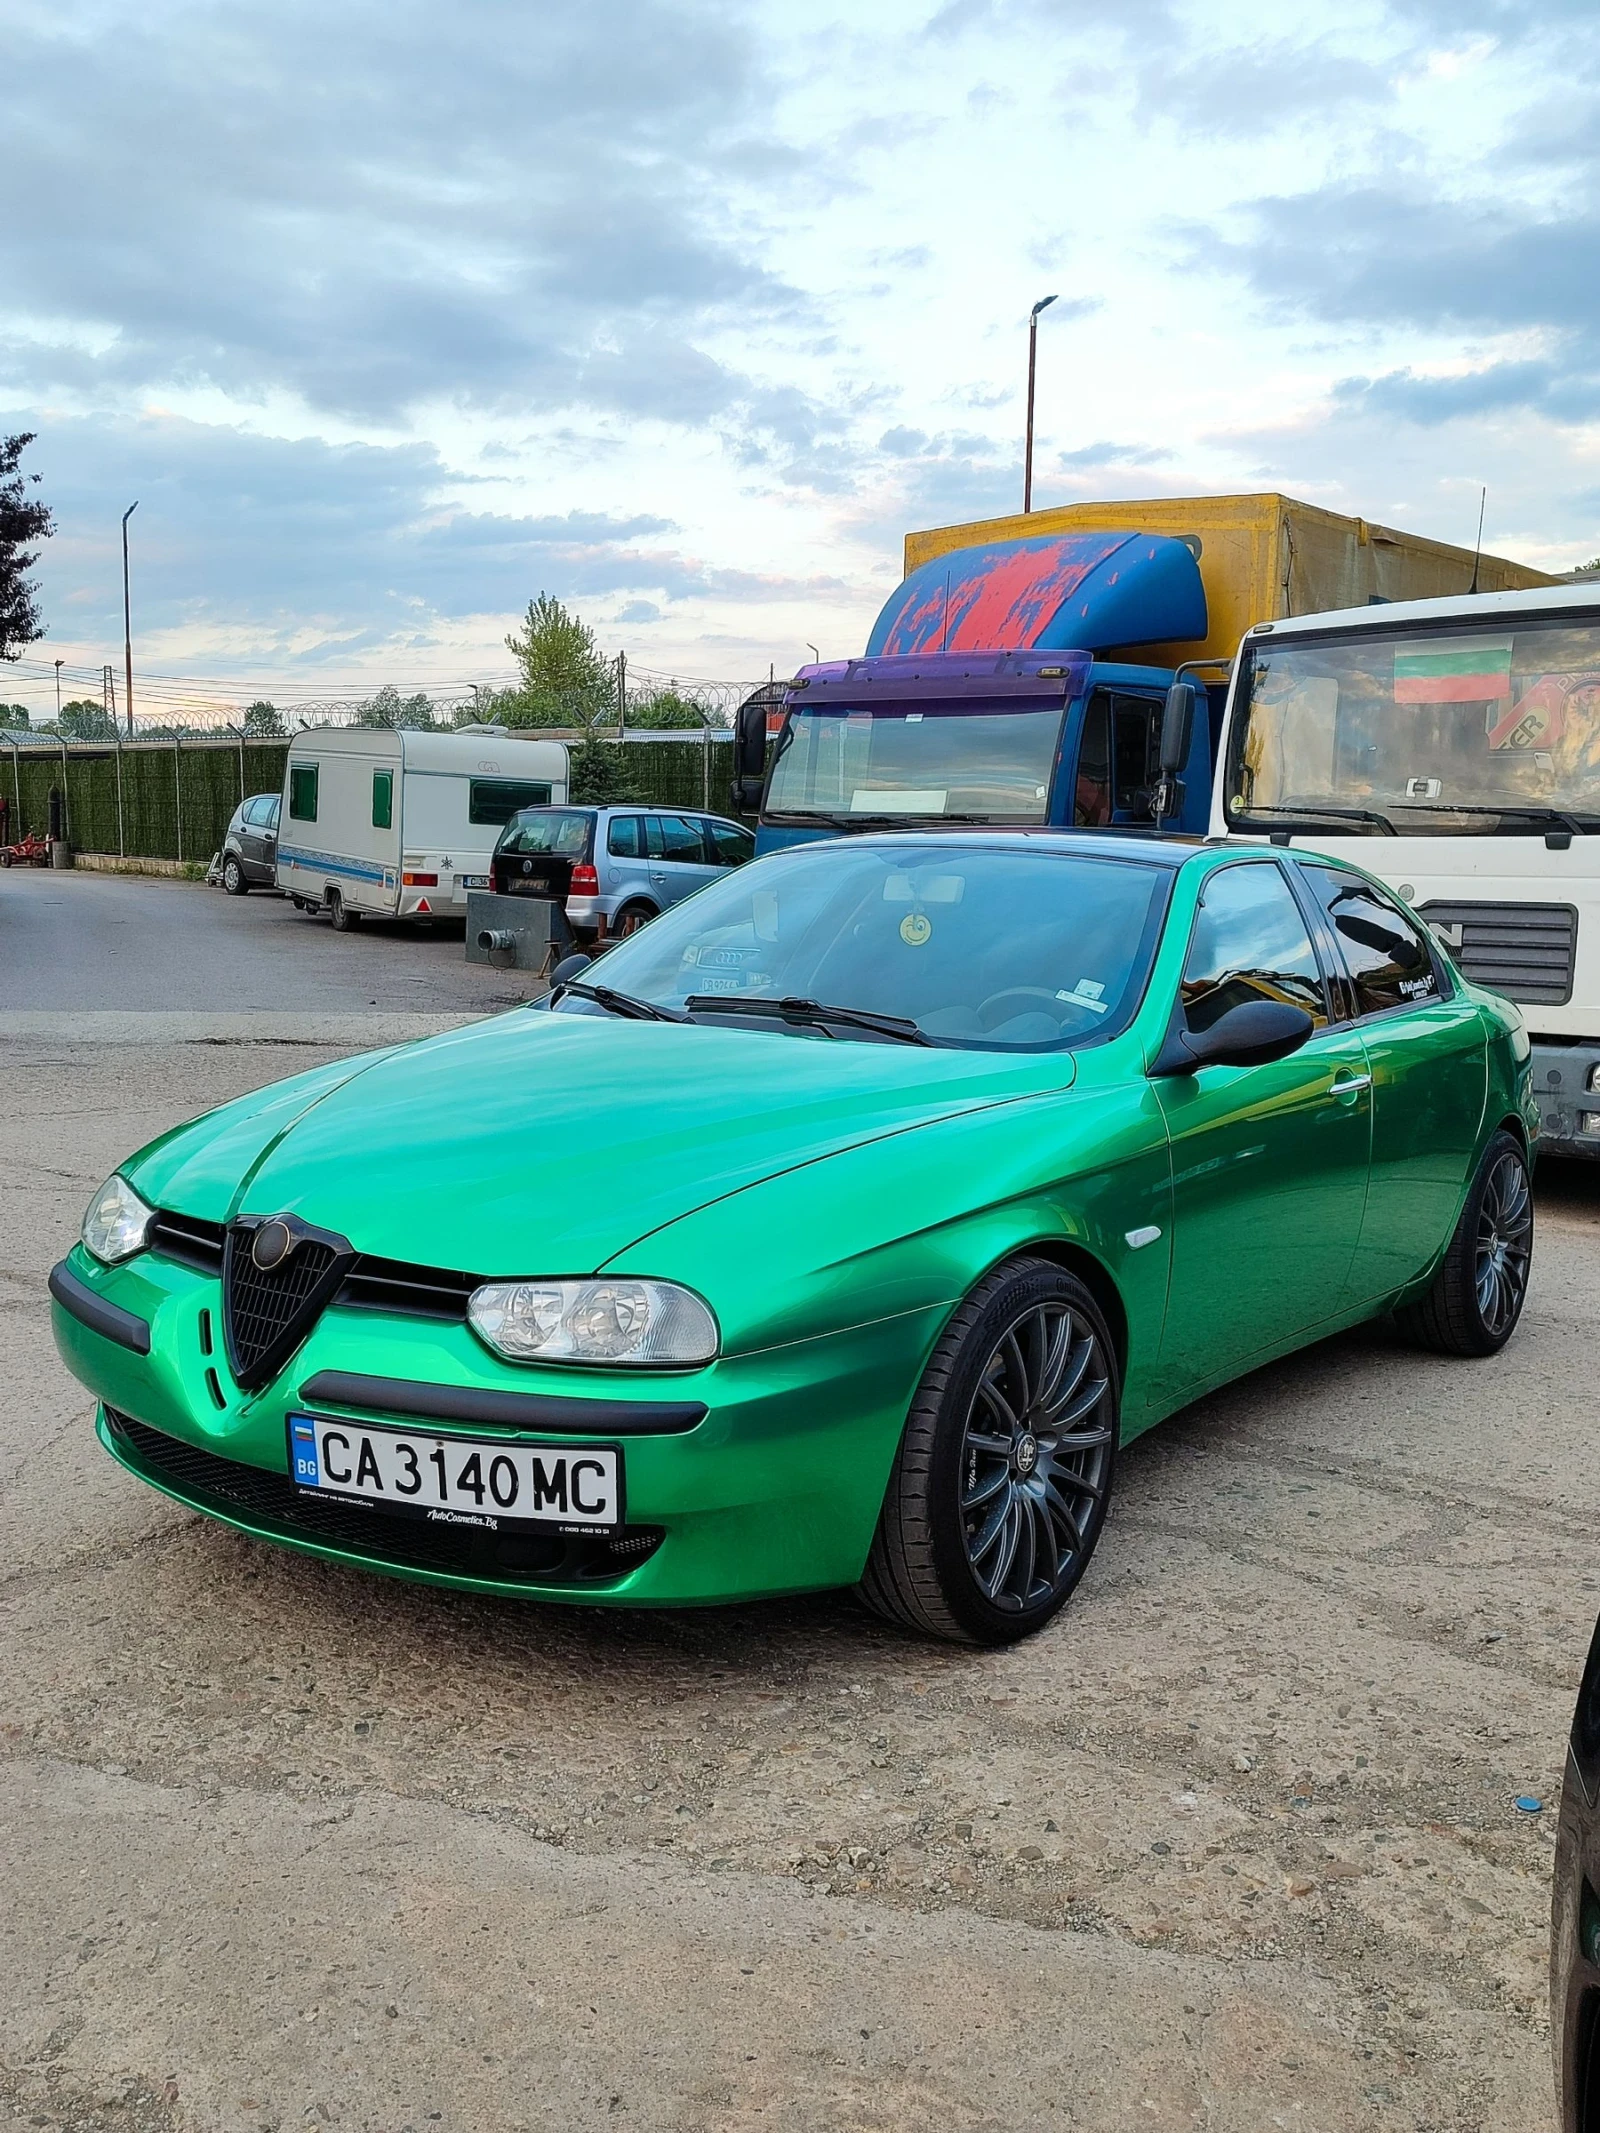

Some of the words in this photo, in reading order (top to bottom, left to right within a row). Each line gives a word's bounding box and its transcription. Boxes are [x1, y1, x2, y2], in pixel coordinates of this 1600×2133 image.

[297, 1458, 316, 1476] BG
[322, 1431, 384, 1491] CA
[395, 1443, 520, 1508] 3140
[532, 1457, 607, 1515] MC
[426, 1509, 498, 1530] AutoCosmetics.Bg
